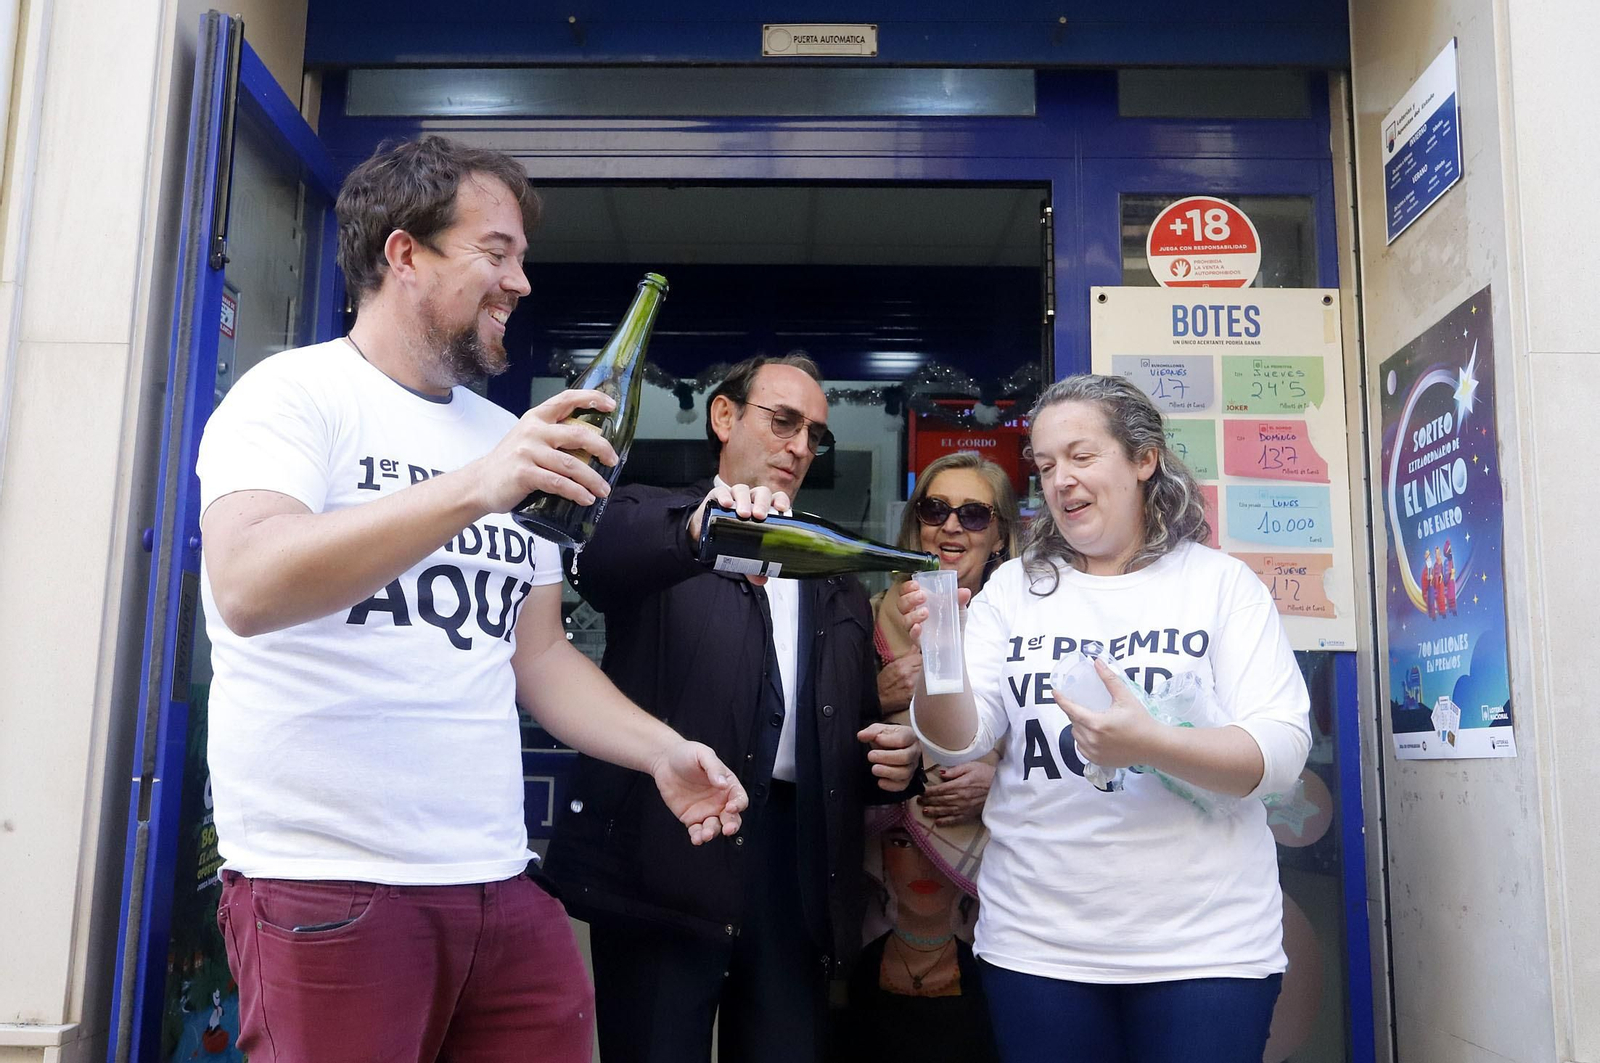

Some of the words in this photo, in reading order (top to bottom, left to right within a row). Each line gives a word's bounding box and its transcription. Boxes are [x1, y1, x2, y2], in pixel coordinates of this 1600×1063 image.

[793, 35, 818, 43] PUERTA
[820, 35, 866, 43] AUTOMATICA
[1169, 208, 1231, 242] +18
[1172, 304, 1261, 338] BOTES
[1151, 377, 1191, 400] 17
[941, 438, 955, 448] EL
[957, 438, 997, 448] GORDO
[1413, 411, 1453, 453] SORTEO
[1452, 437, 1460, 452] DE
[1403, 479, 1423, 518] EL
[1423, 457, 1468, 509] NIÑO
[1257, 511, 1315, 534] 10.000
[1417, 521, 1423, 540] 6
[1423, 513, 1434, 538] DE
[1434, 506, 1463, 533] ENERO
[1417, 640, 1433, 659] 700
[1433, 633, 1469, 656] MILLONES
[1426, 659, 1435, 673] EN
[1435, 654, 1461, 672] PREMIOS
